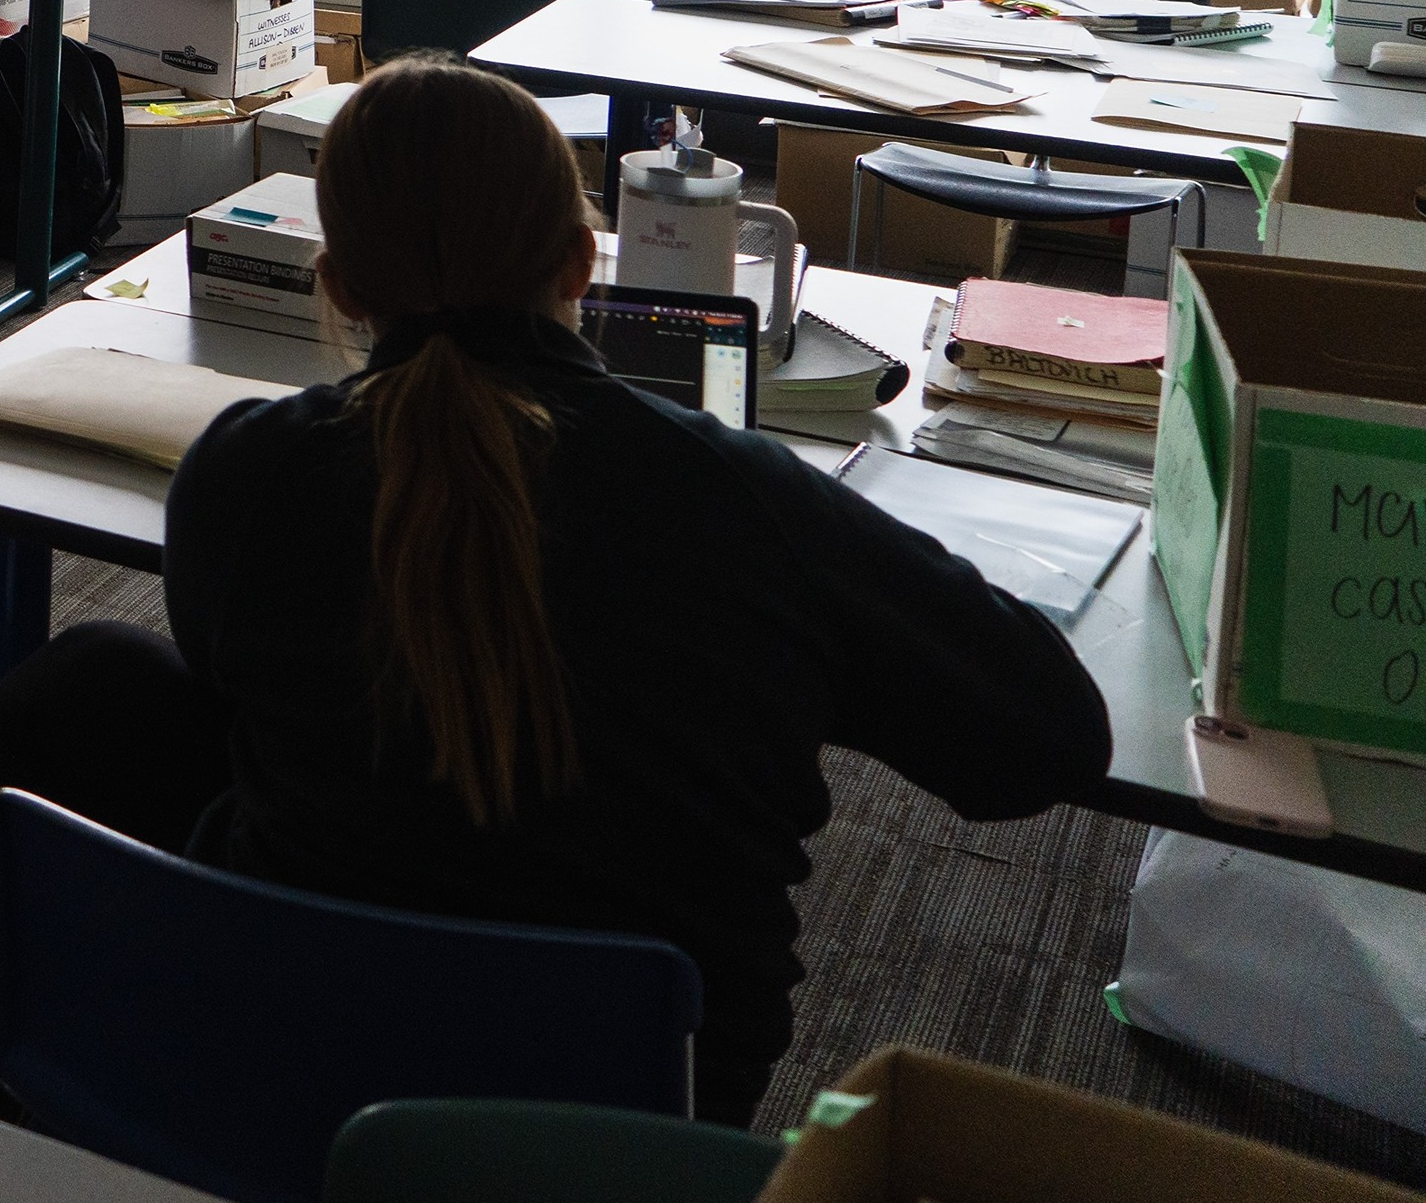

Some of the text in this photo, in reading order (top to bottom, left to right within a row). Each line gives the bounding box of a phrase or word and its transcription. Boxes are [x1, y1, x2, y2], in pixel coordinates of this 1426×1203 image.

[257, 11, 291, 31] WITNESSES
[164, 55, 213, 71] BANKERS BOX
[637, 233, 691, 250] STANLEY
[207, 253, 313, 283] PRESENTATION BINDINGS
[207, 265, 247, 279] PRESENTATION
[983, 345, 1119, 386] BALTOVICH
